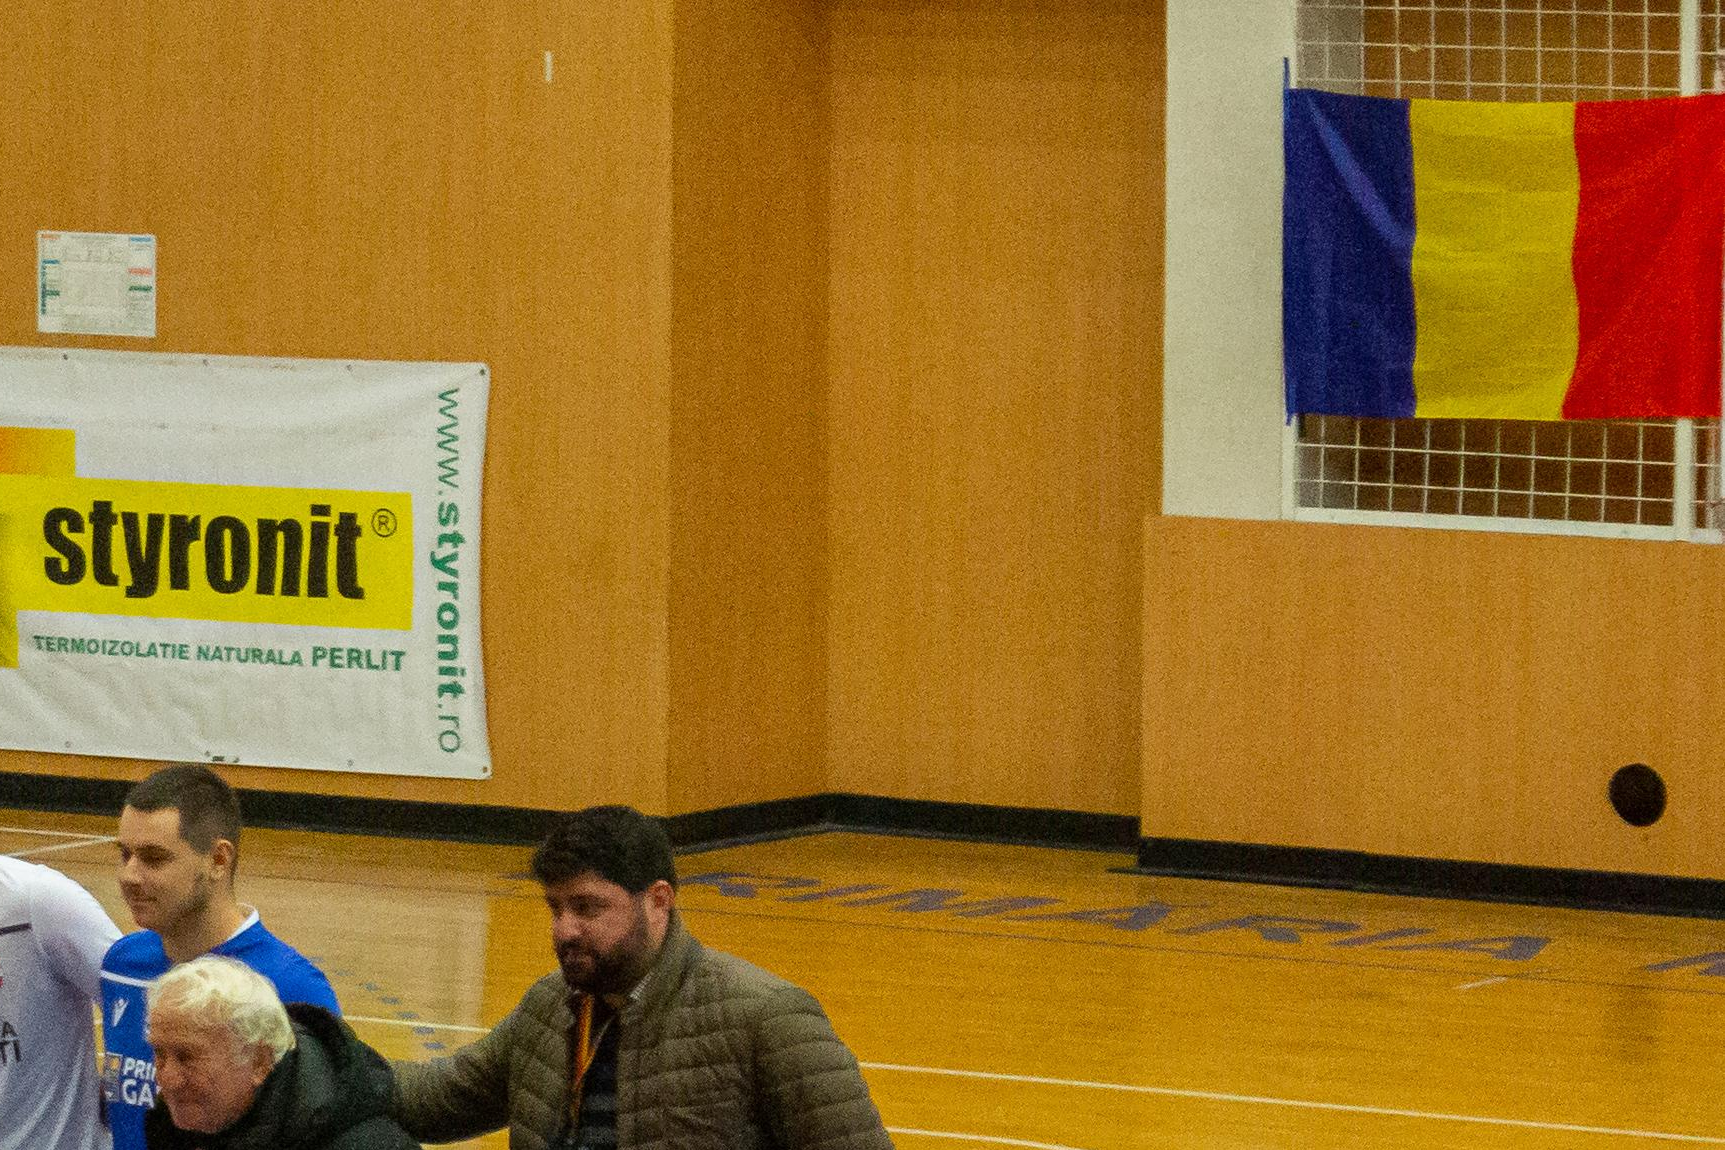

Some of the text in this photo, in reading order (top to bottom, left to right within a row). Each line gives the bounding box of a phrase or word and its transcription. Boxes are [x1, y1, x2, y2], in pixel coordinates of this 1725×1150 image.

[42, 500, 365, 600] styronit
[427, 387, 468, 755] www.styronit.ro
[33, 634, 406, 673] TERMOIZOLATIE NATURALA PERLIT
[123, 1057, 157, 1081] PRI
